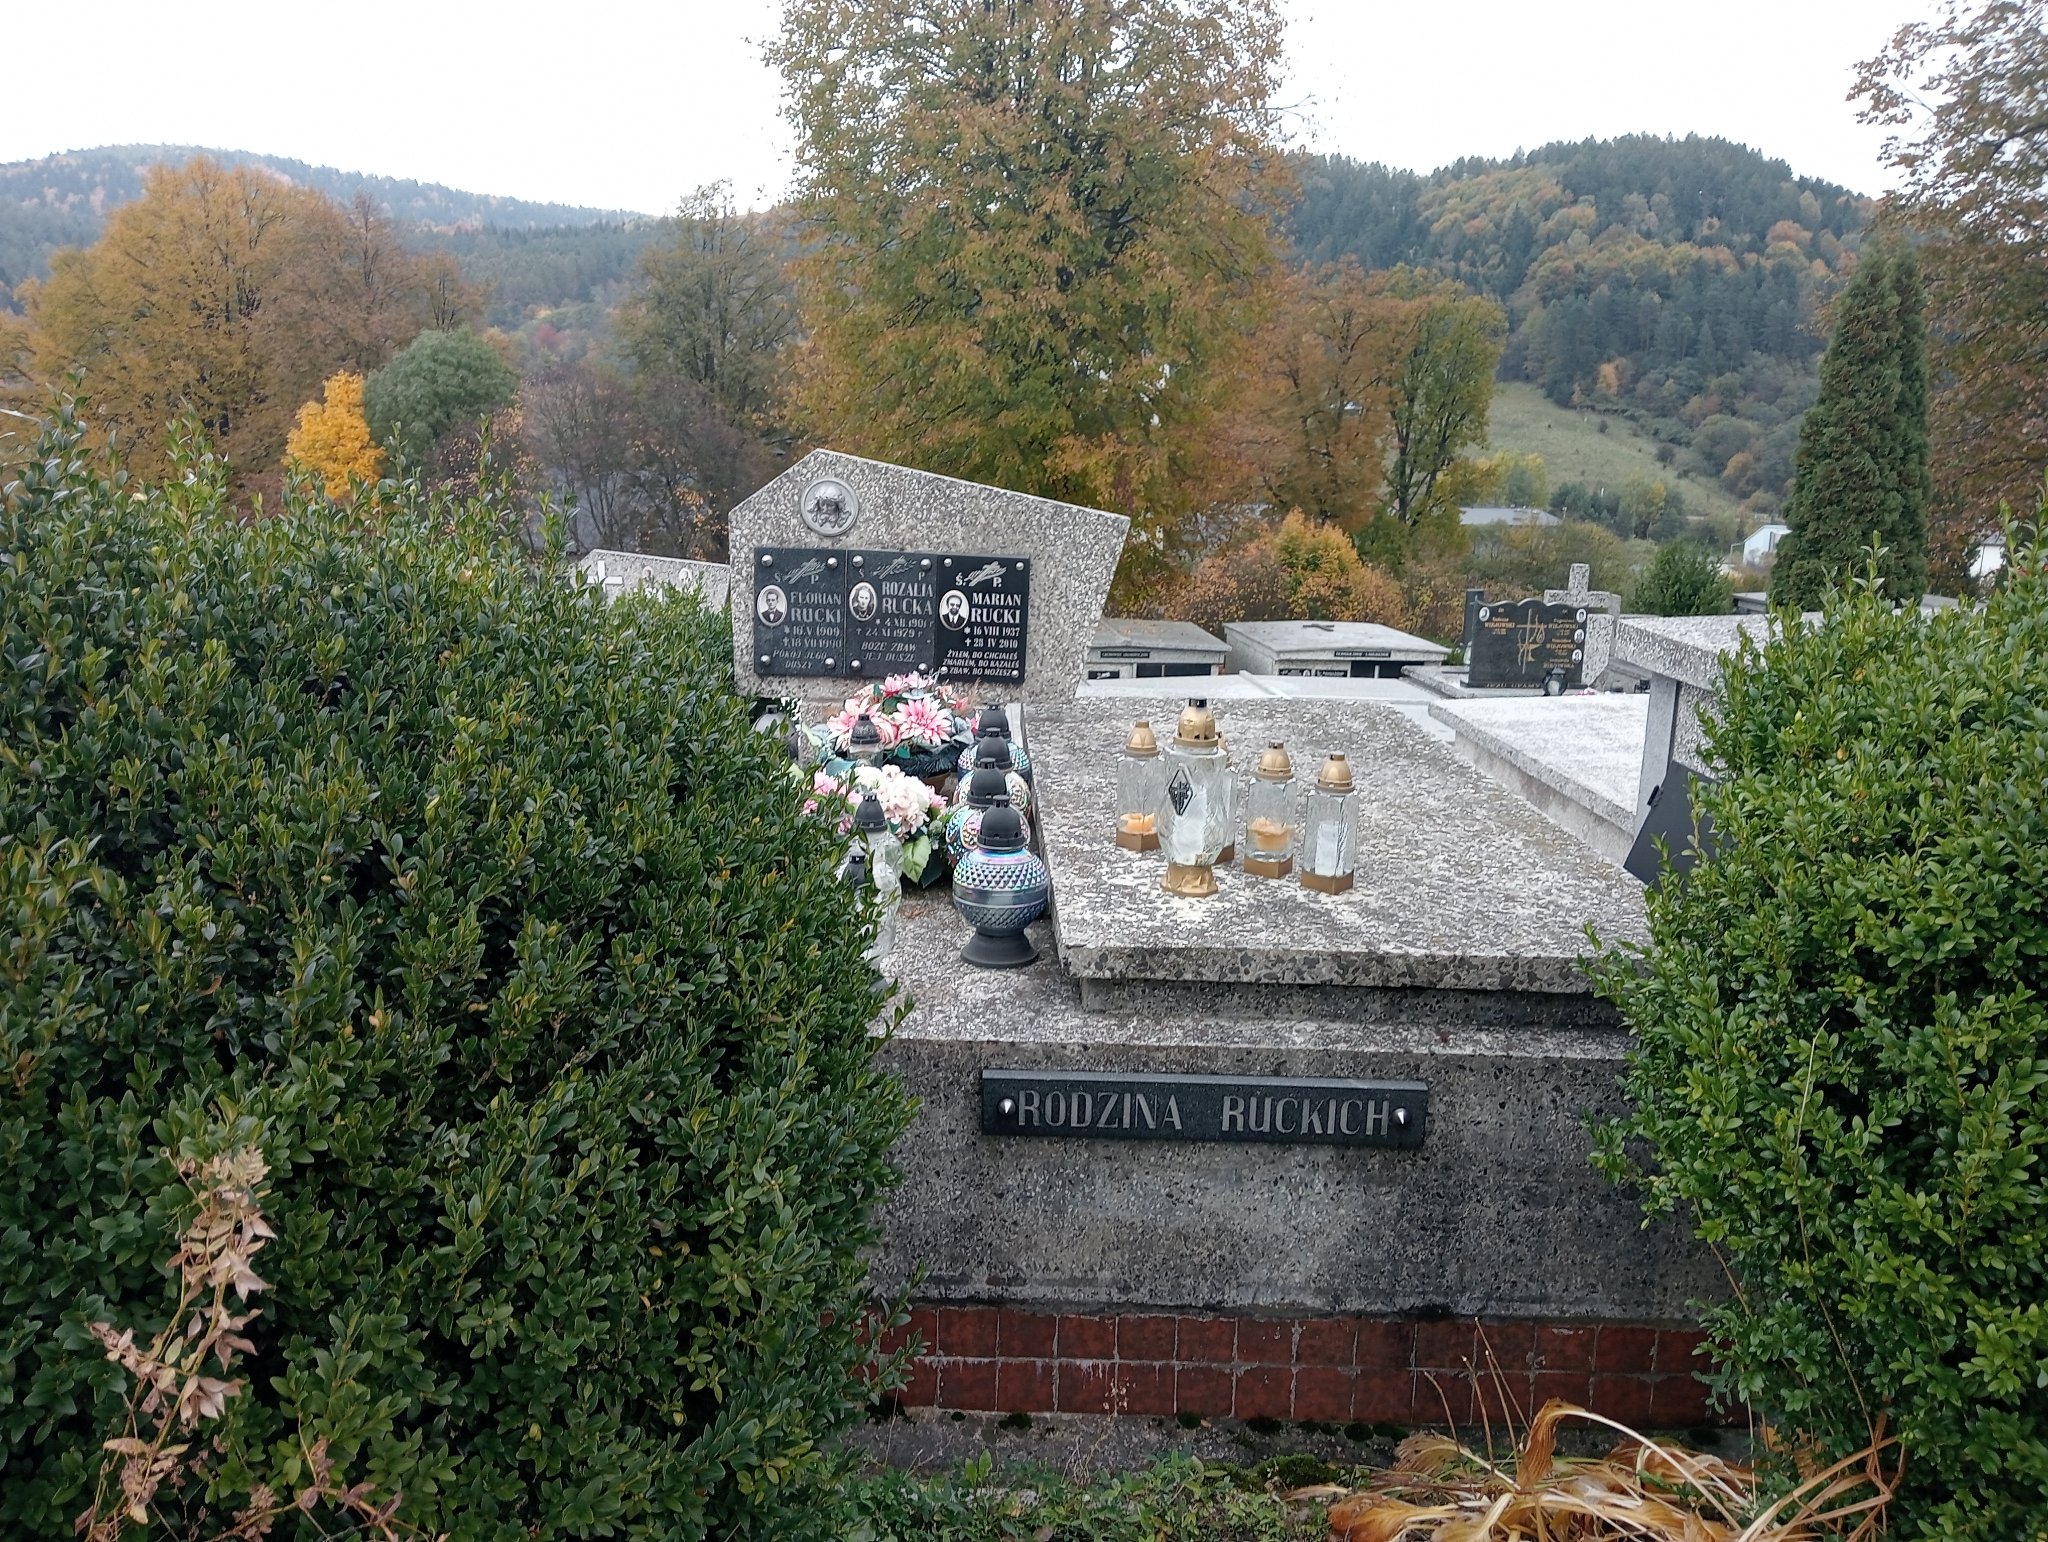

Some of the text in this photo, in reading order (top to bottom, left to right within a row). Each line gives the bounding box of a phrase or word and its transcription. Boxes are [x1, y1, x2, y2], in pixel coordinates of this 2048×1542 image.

[882, 581, 933, 597] ROZALIA
[790, 591, 842, 605] FLORIAN
[972, 592, 1021, 606] MARIAN
[882, 598, 933, 615] RUCKA
[791, 608, 841, 623] RUCKI
[970, 608, 1021, 624] RUCKI
[893, 628, 916, 638] 1979
[974, 626, 1020, 637] 16 VIII 1937
[890, 642, 916, 652] ZBAW
[988, 639, 997, 648] IV
[999, 639, 1018, 648] 2010
[972, 651, 983, 659] BO
[978, 660, 989, 668] BO
[972, 668, 982, 676] BO
[1017, 1088, 1390, 1136] RODZINA RUCKICH
